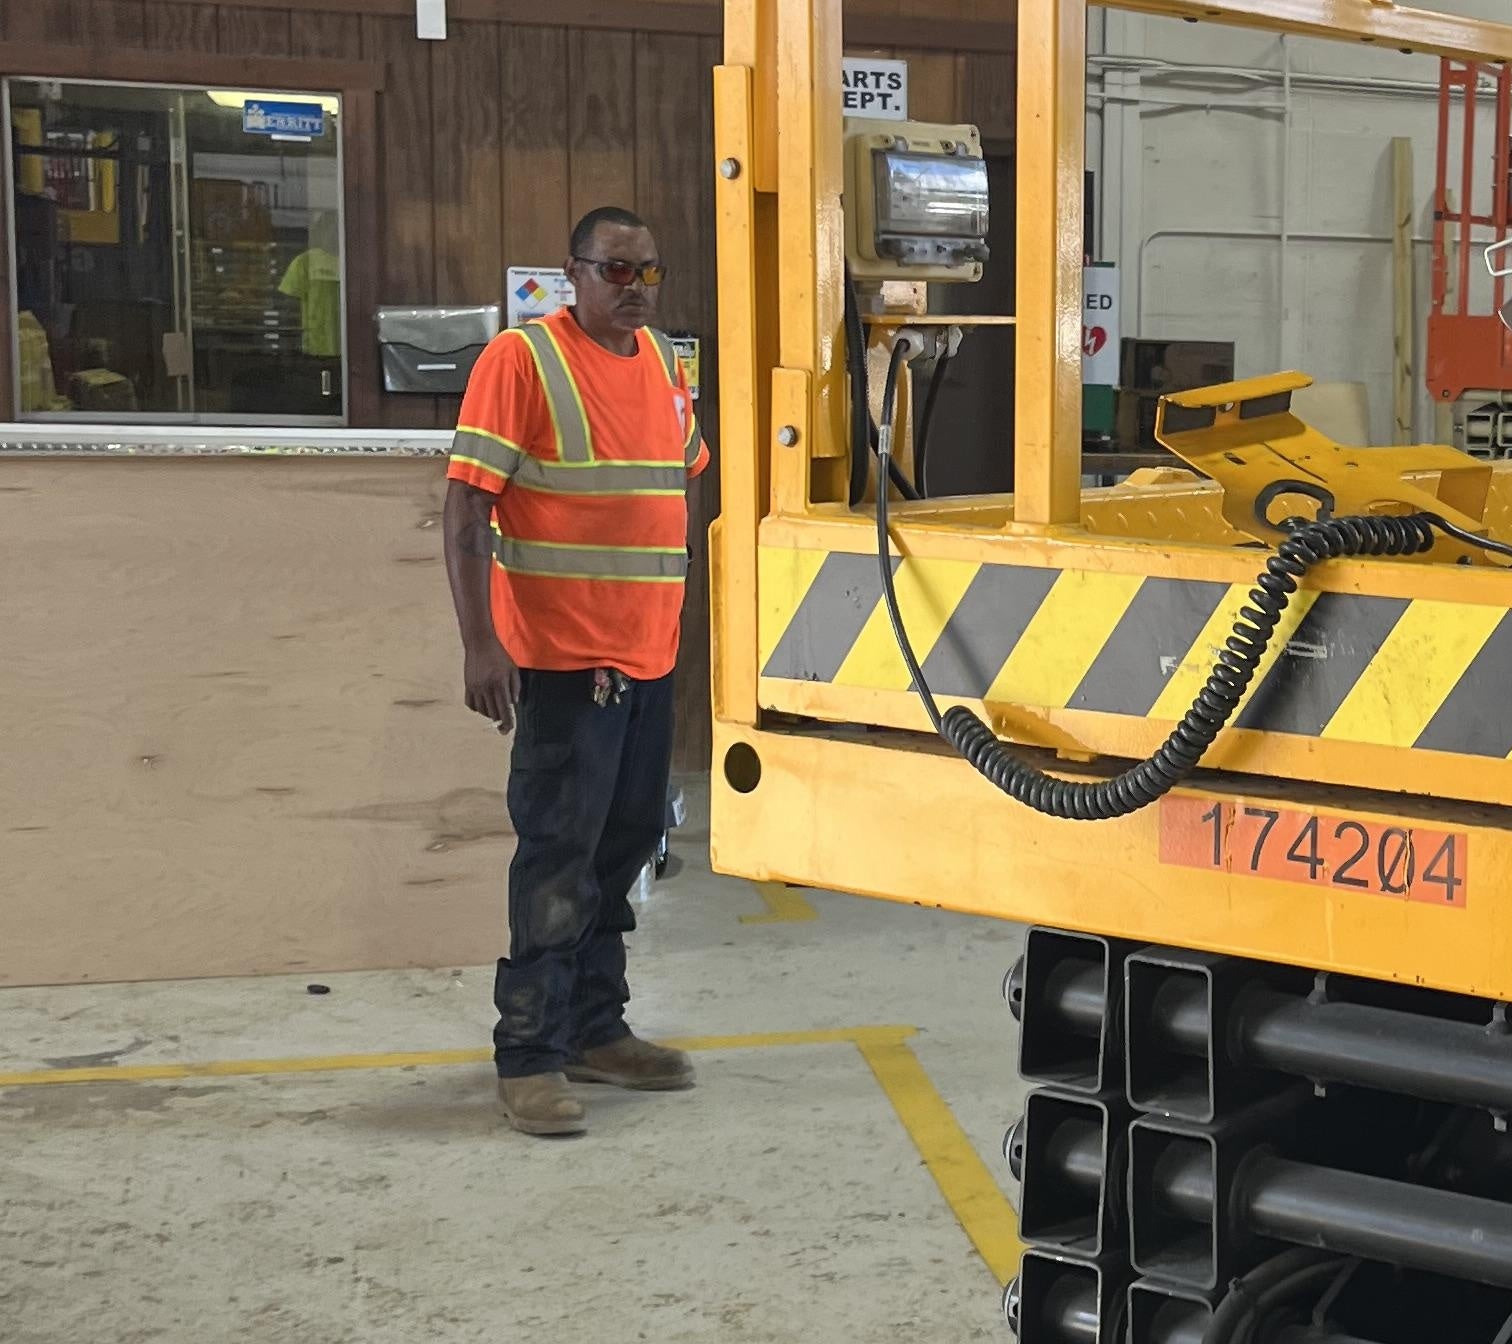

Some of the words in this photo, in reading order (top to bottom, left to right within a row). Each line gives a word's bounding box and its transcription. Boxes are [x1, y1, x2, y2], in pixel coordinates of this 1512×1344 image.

[842, 70, 902, 90] ARTS
[843, 91, 900, 111] EPT.
[1086, 293, 1112, 310] ED
[1201, 801, 1463, 901] 174204
